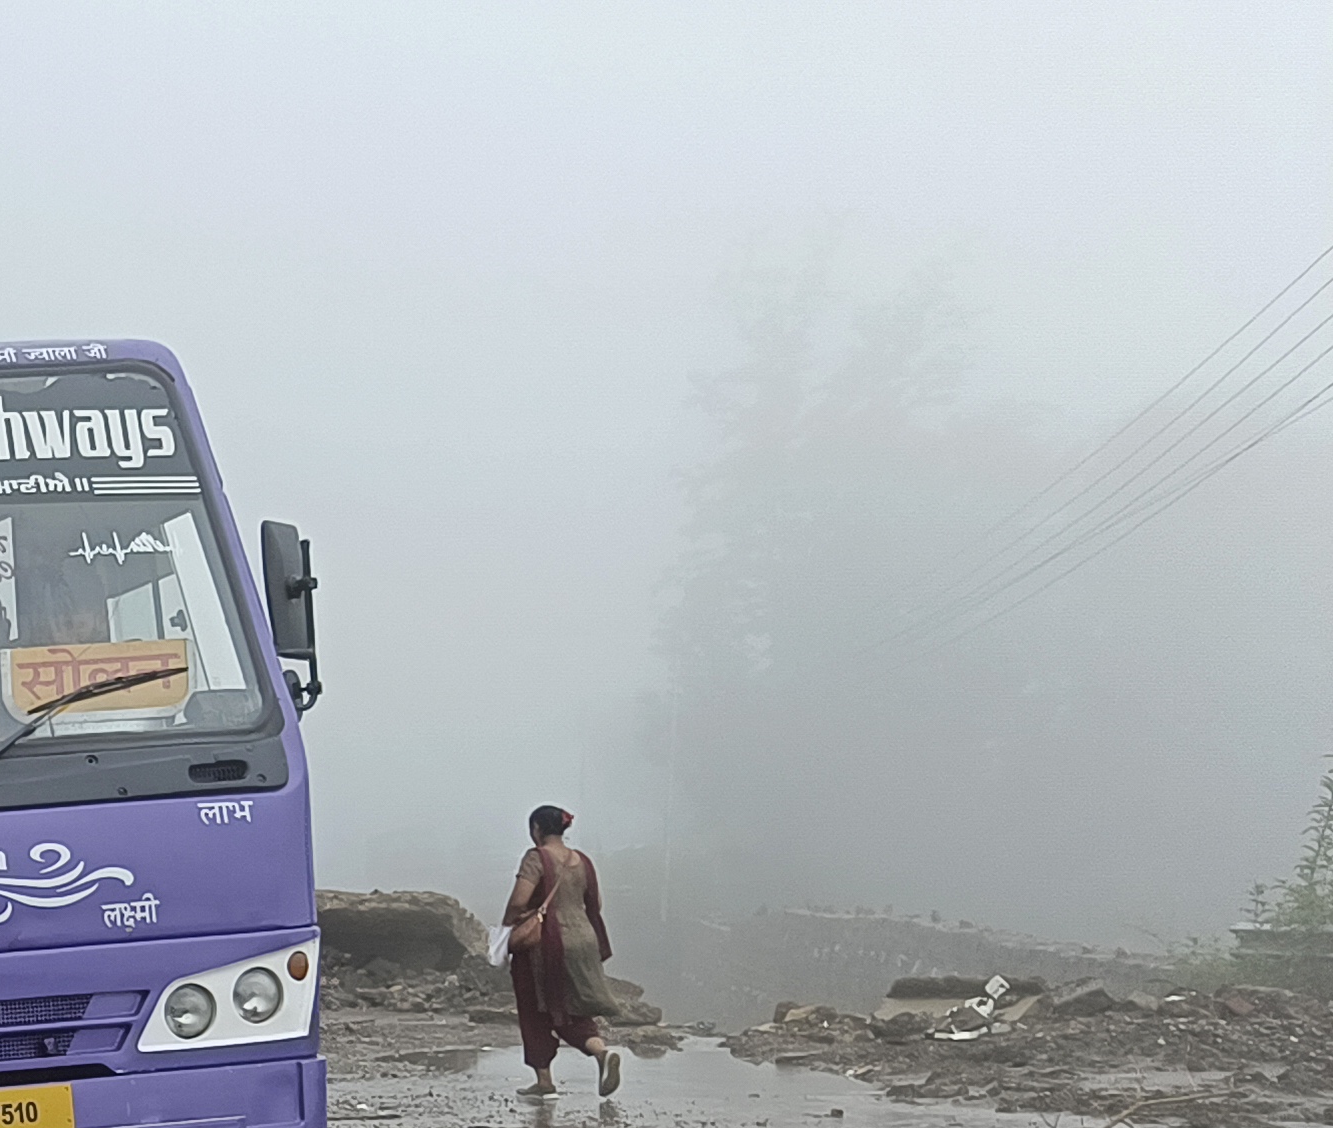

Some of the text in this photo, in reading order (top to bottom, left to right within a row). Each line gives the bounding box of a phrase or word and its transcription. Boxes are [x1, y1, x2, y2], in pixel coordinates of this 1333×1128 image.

[82, 343, 107, 359] जी
[198, 800, 254, 825] लाभ
[100, 892, 161, 929] लक्ष्मी
